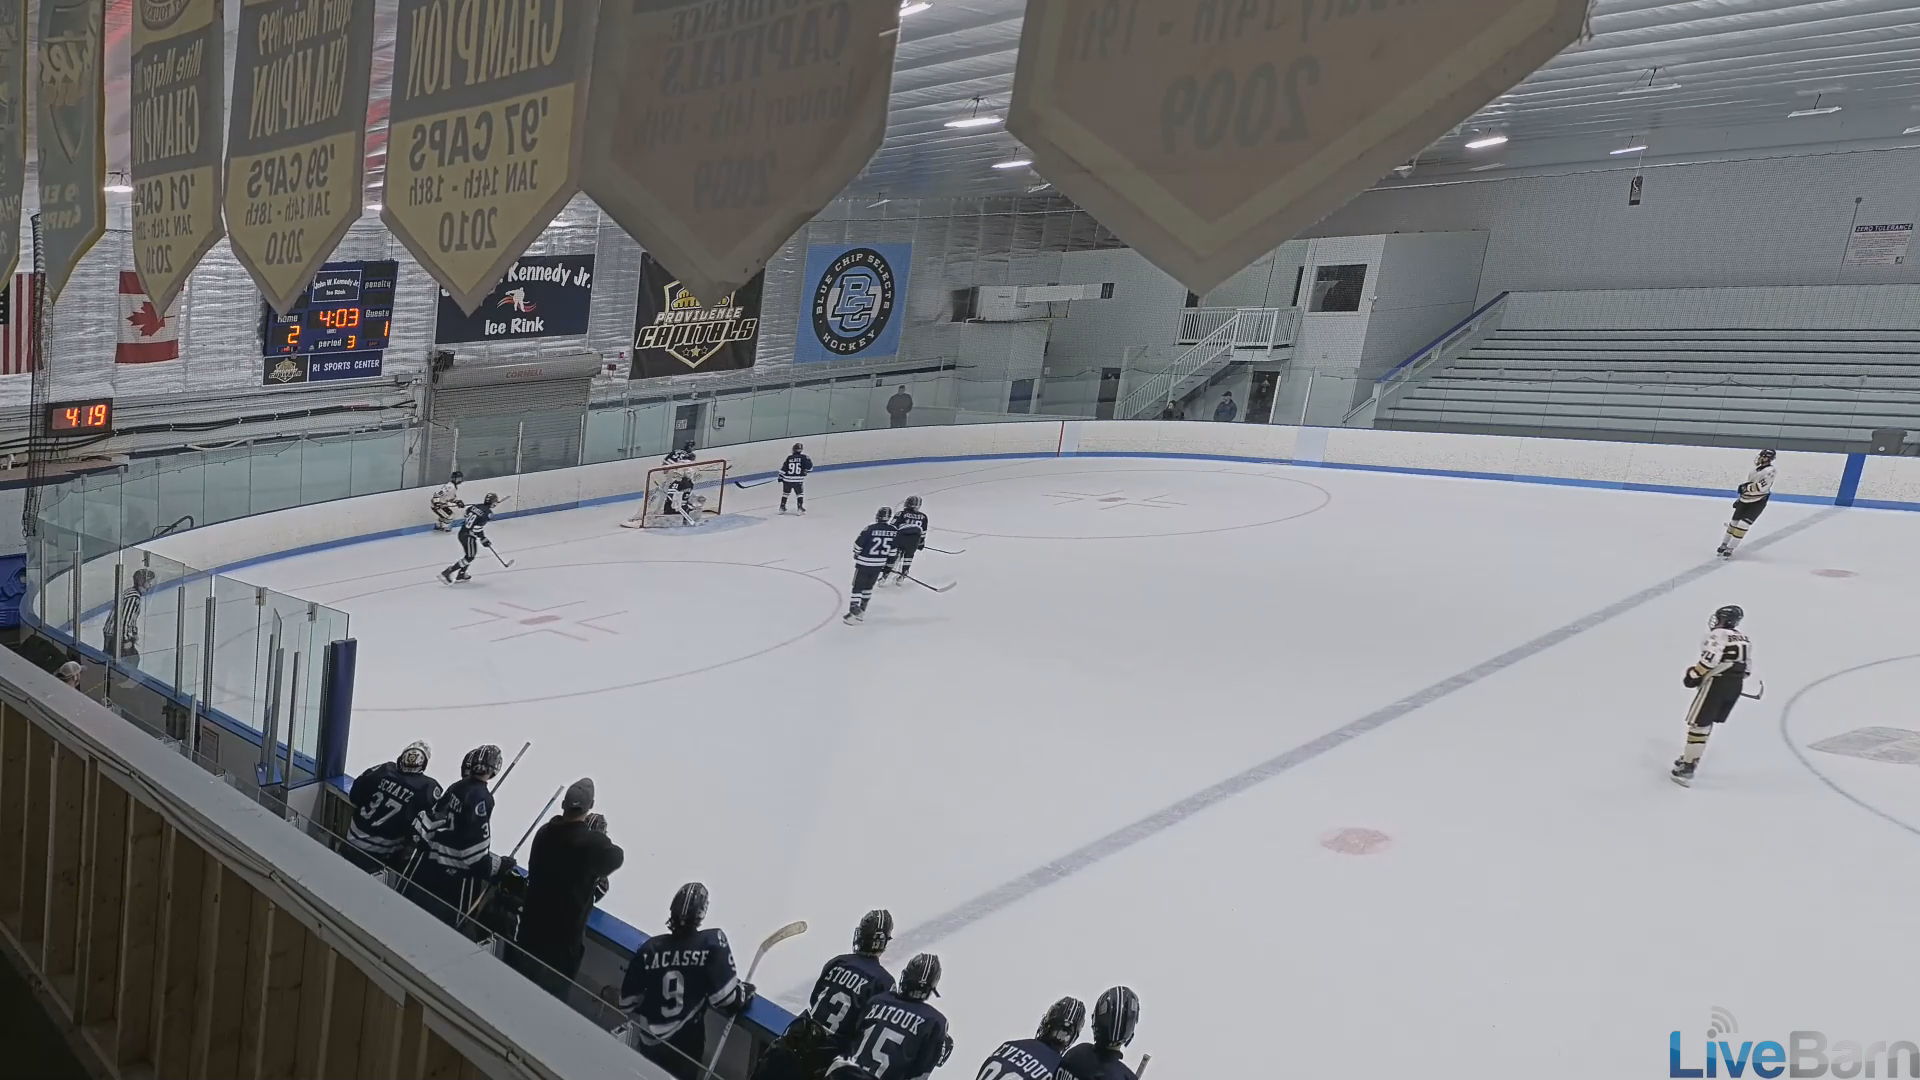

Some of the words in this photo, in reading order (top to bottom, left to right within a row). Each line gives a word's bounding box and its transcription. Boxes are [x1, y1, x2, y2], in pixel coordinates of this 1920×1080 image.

[364, 279, 391, 290] penalty
[507, 261, 571, 287] Kennedy
[574, 266, 592, 289] Jr.
[816, 274, 833, 314] BLUE
[834, 253, 863, 272] CHIP
[867, 254, 892, 309] SELECTS
[319, 308, 359, 327] 4:03
[484, 319, 507, 336] Ice
[510, 316, 545, 334] Rink
[287, 325, 300, 344] 2
[318, 338, 342, 349] period
[346, 335, 356, 349] 3
[635, 318, 758, 351] CAPITALS
[822, 329, 876, 351] HOCKEY
[312, 363, 320, 373] RI
[323, 361, 351, 372] SPORTS
[353, 359, 380, 370] CENTER
[66, 404, 106, 427] 4:19
[787, 462, 802, 475] 96
[869, 537, 893, 556] 25
[377, 778, 415, 803] SCHATZ
[360, 791, 403, 827] 37
[824, 966, 869, 995] STOOK
[660, 970, 685, 1018] 9
[850, 1023, 906, 1080] 15
